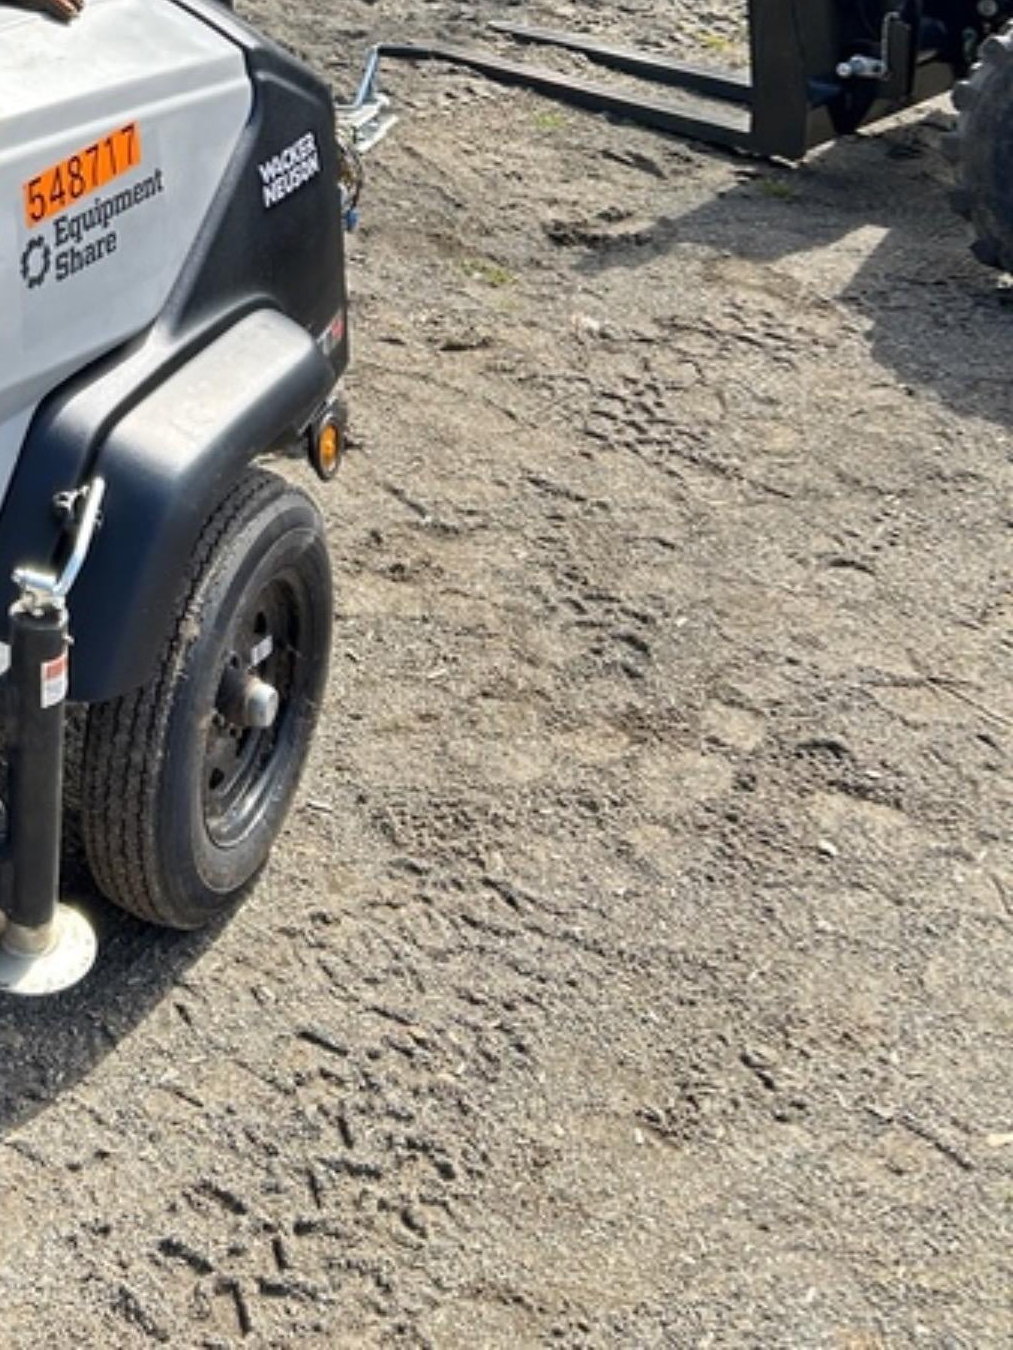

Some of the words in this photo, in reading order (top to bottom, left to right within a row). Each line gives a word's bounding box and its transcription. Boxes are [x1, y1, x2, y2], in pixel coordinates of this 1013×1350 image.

[27, 123, 135, 222] 548717
[258, 132, 316, 184] WACKER
[263, 152, 320, 207] NEUSON
[53, 168, 164, 246] Equipment
[55, 231, 118, 282] Share
